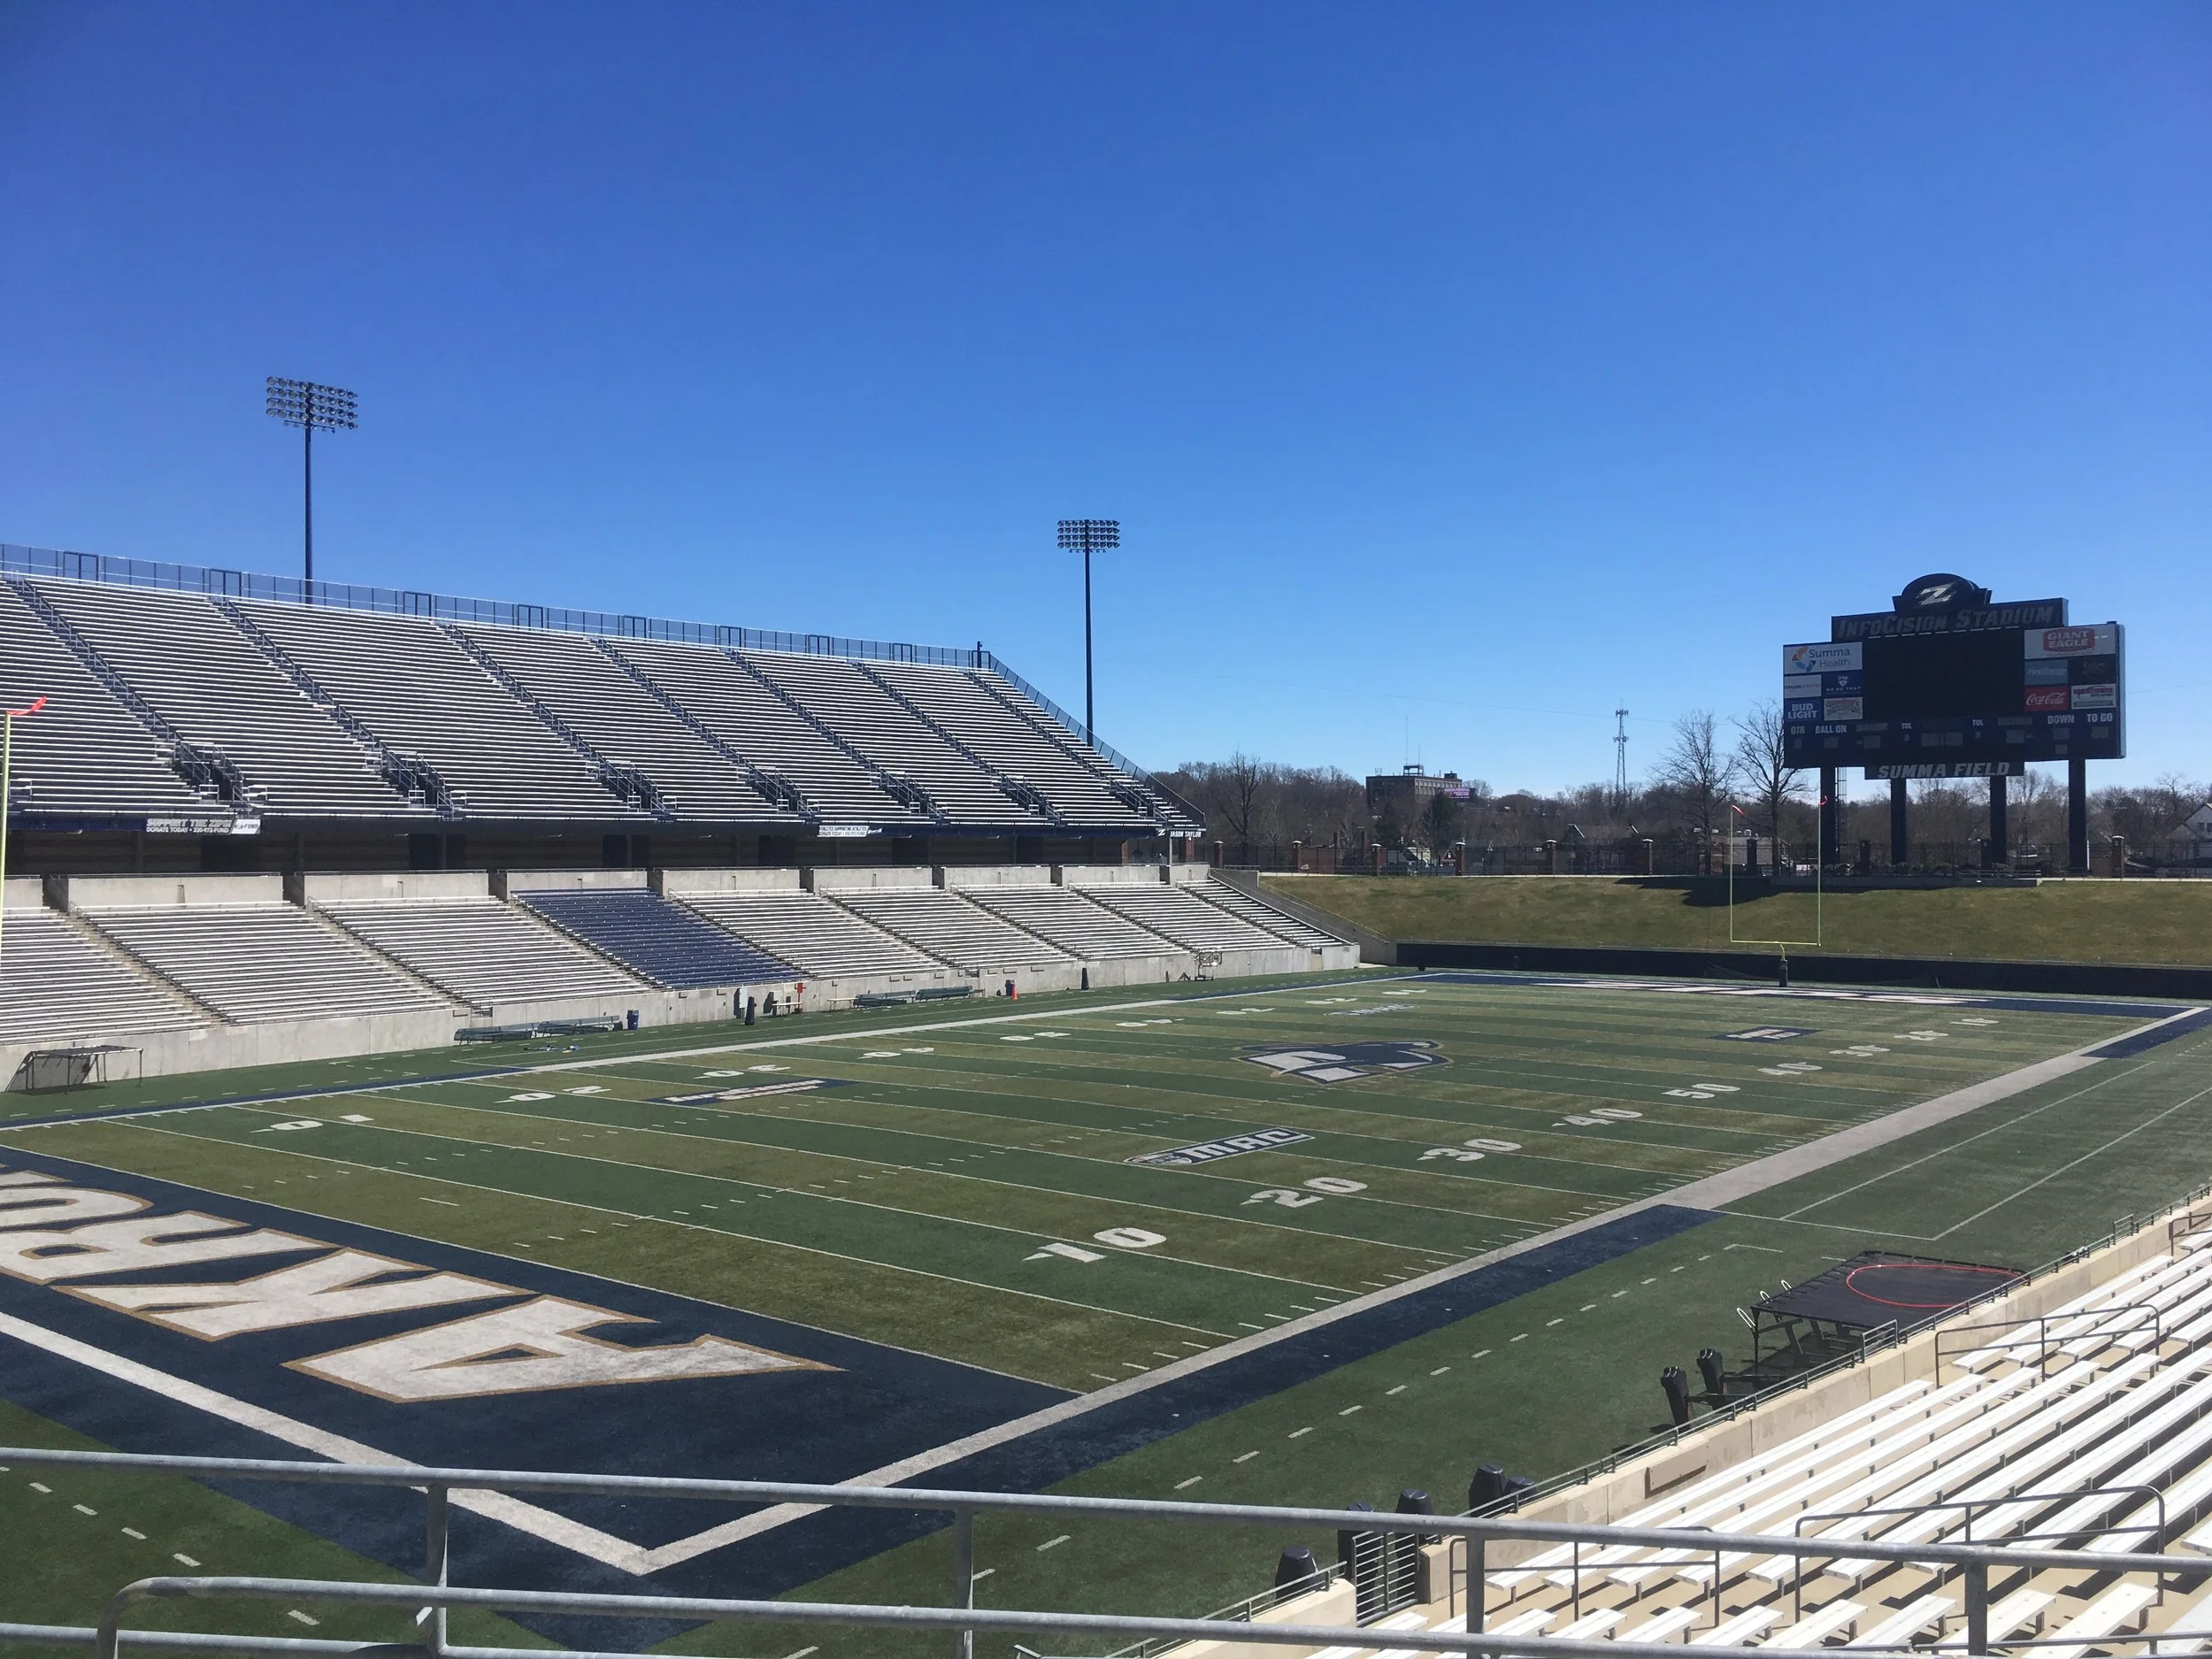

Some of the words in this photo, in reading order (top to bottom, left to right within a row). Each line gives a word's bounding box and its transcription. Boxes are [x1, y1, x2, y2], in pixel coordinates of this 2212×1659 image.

[1954, 605, 2054, 628] STADIUM
[2047, 630, 2089, 640] GIANT
[2048, 639, 2089, 648] EAGLE
[1809, 648, 1851, 657] Summa
[1819, 658, 1851, 668] Health
[1787, 710, 1818, 719] LIGHT
[2047, 715, 2075, 724] DOWN
[2085, 713, 2098, 722] TO
[2101, 713, 2113, 722] GO
[1790, 726, 1806, 734] QTR
[1815, 725, 1833, 733] BALL
[1878, 764, 1947, 779] SUMMA
[1954, 762, 2010, 777] FIELD
[1662, 1083, 1740, 1099] 50
[1563, 1108, 1644, 1127] 40
[1177, 1128, 1308, 1159] MAC
[1423, 1138, 1523, 1162] 30
[1249, 1177, 1368, 1209] 20
[1037, 1227, 1168, 1263] 10
[0, 1163, 851, 1403] AKR
